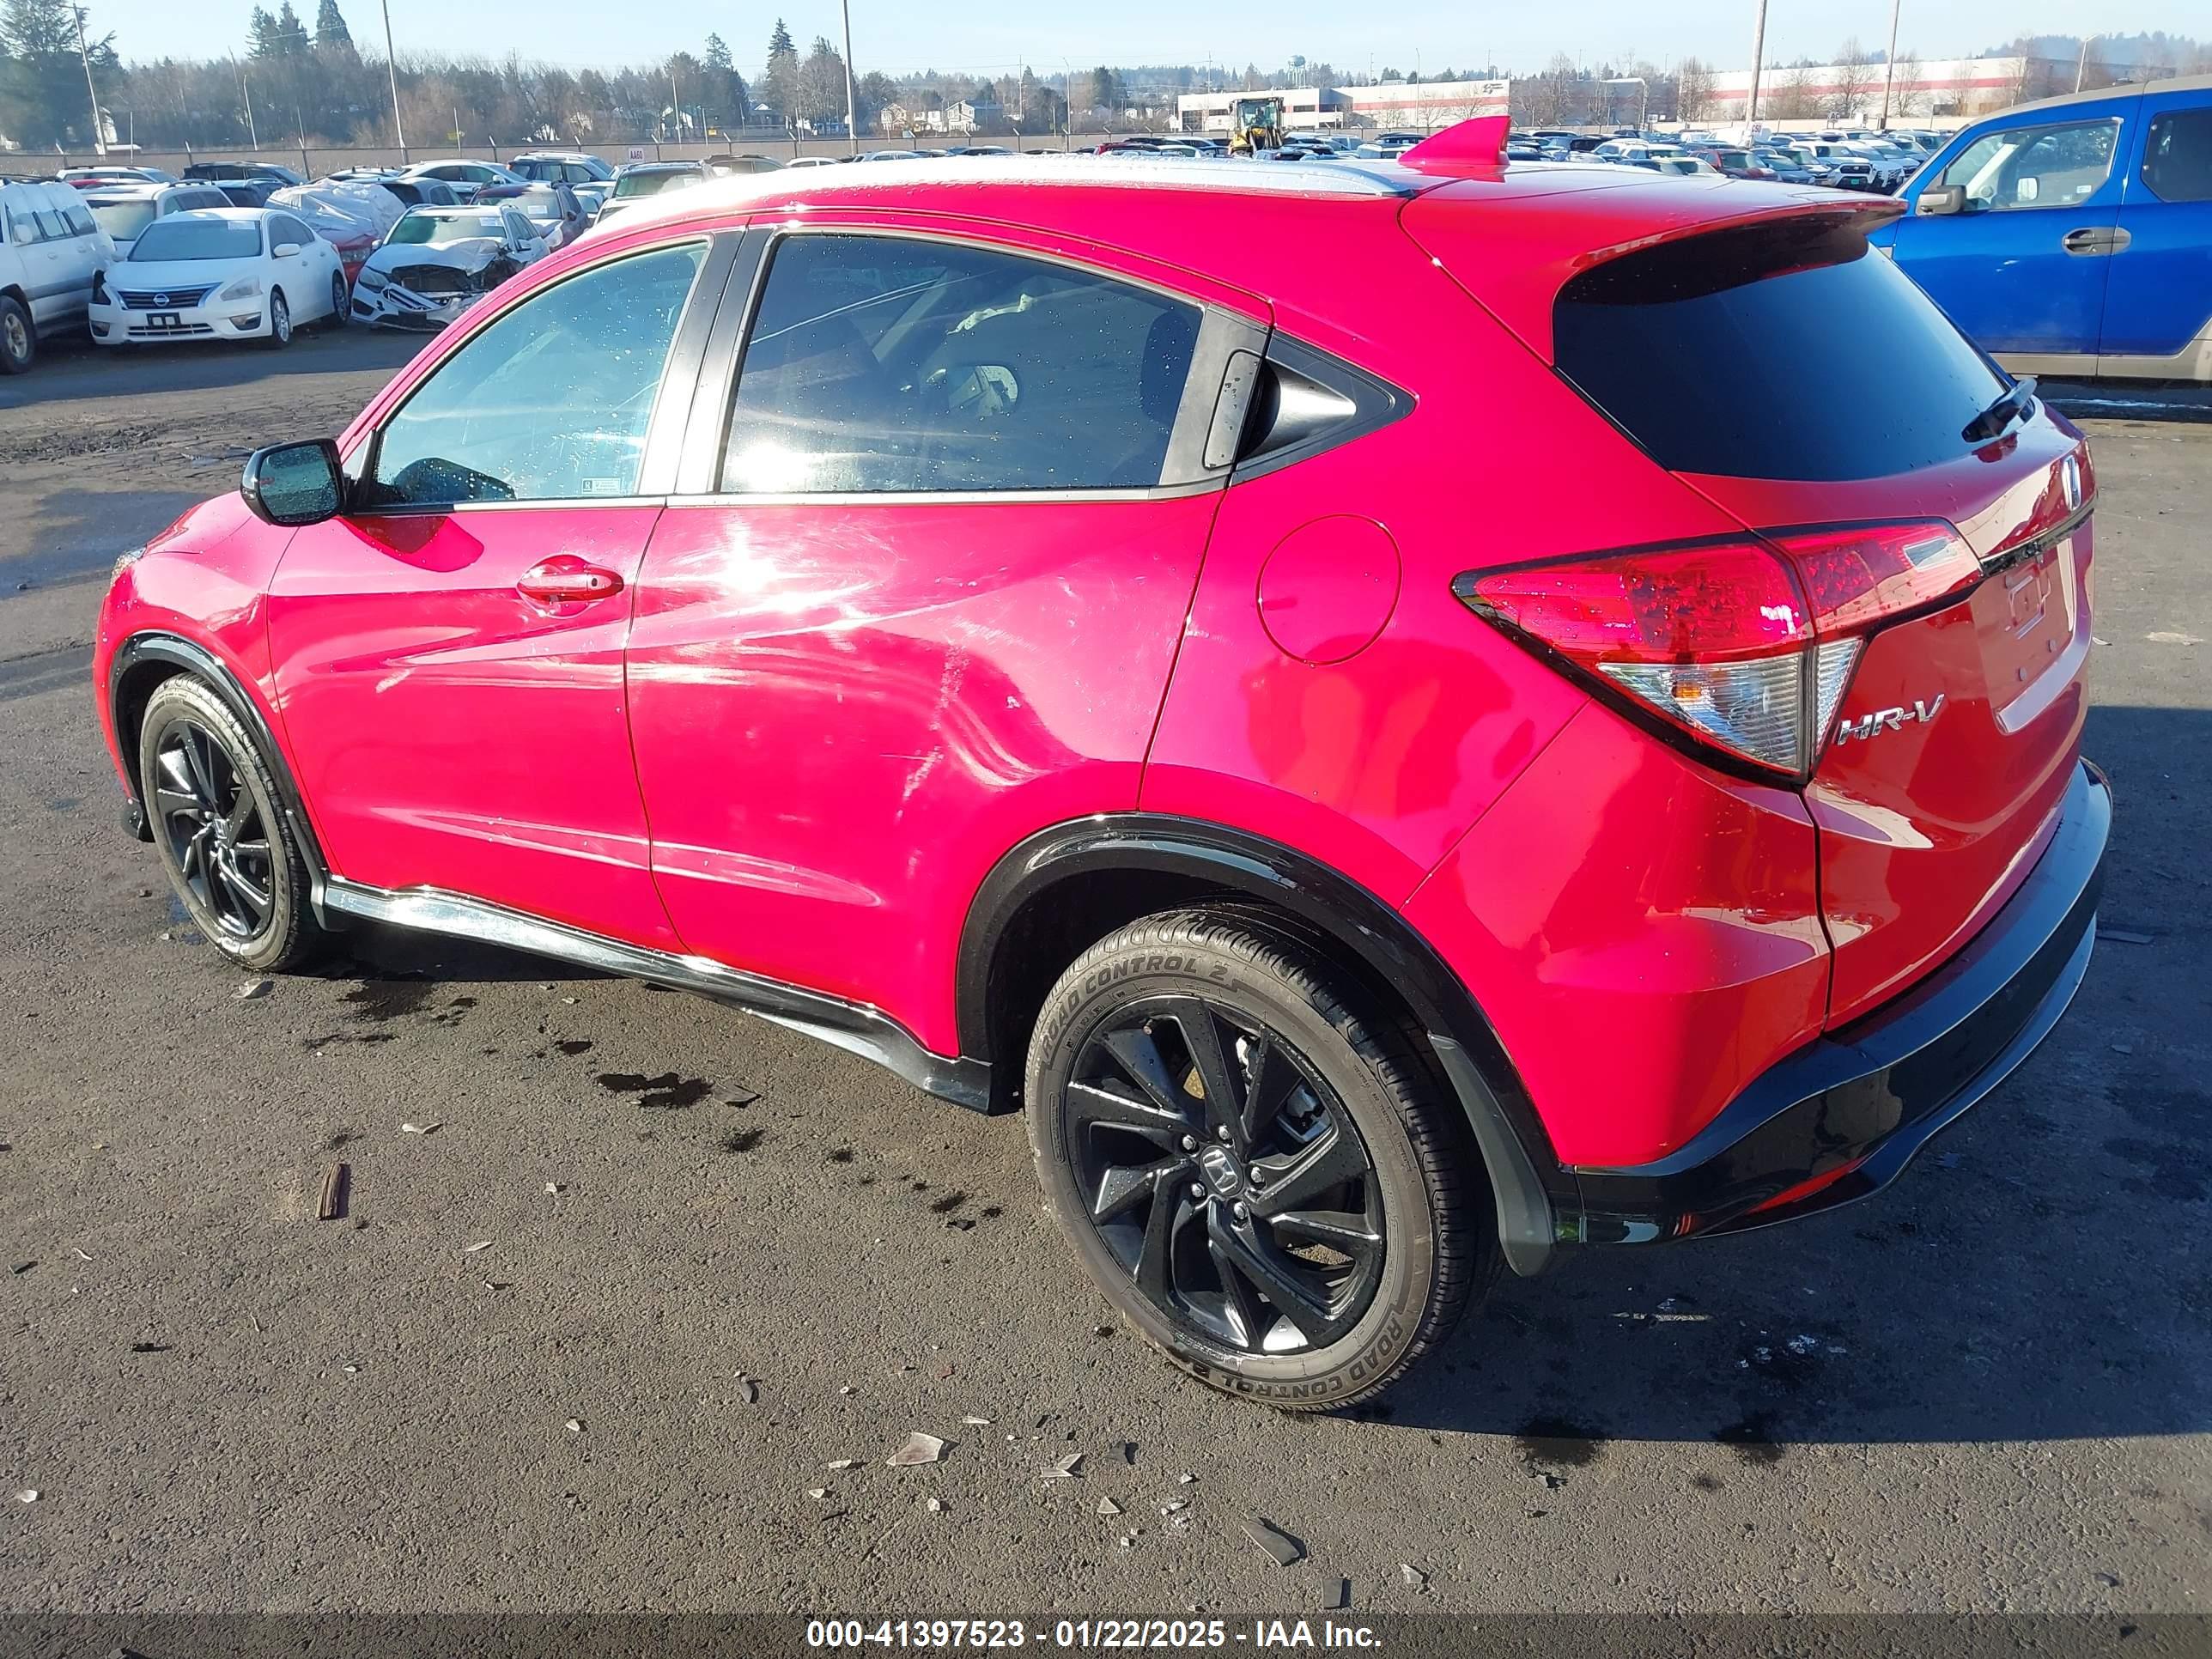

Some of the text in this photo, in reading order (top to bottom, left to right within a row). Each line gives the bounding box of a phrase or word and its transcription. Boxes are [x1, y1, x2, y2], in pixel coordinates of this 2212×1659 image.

[1837, 693, 1945, 745] HR-V
[1042, 990, 1080, 1059] ROAD
[1085, 955, 1197, 994] CONTROL
[1208, 964, 1229, 981] 2
[1349, 1316, 1403, 1381] ROAD
[1222, 1374, 1343, 1399] CONTROL
